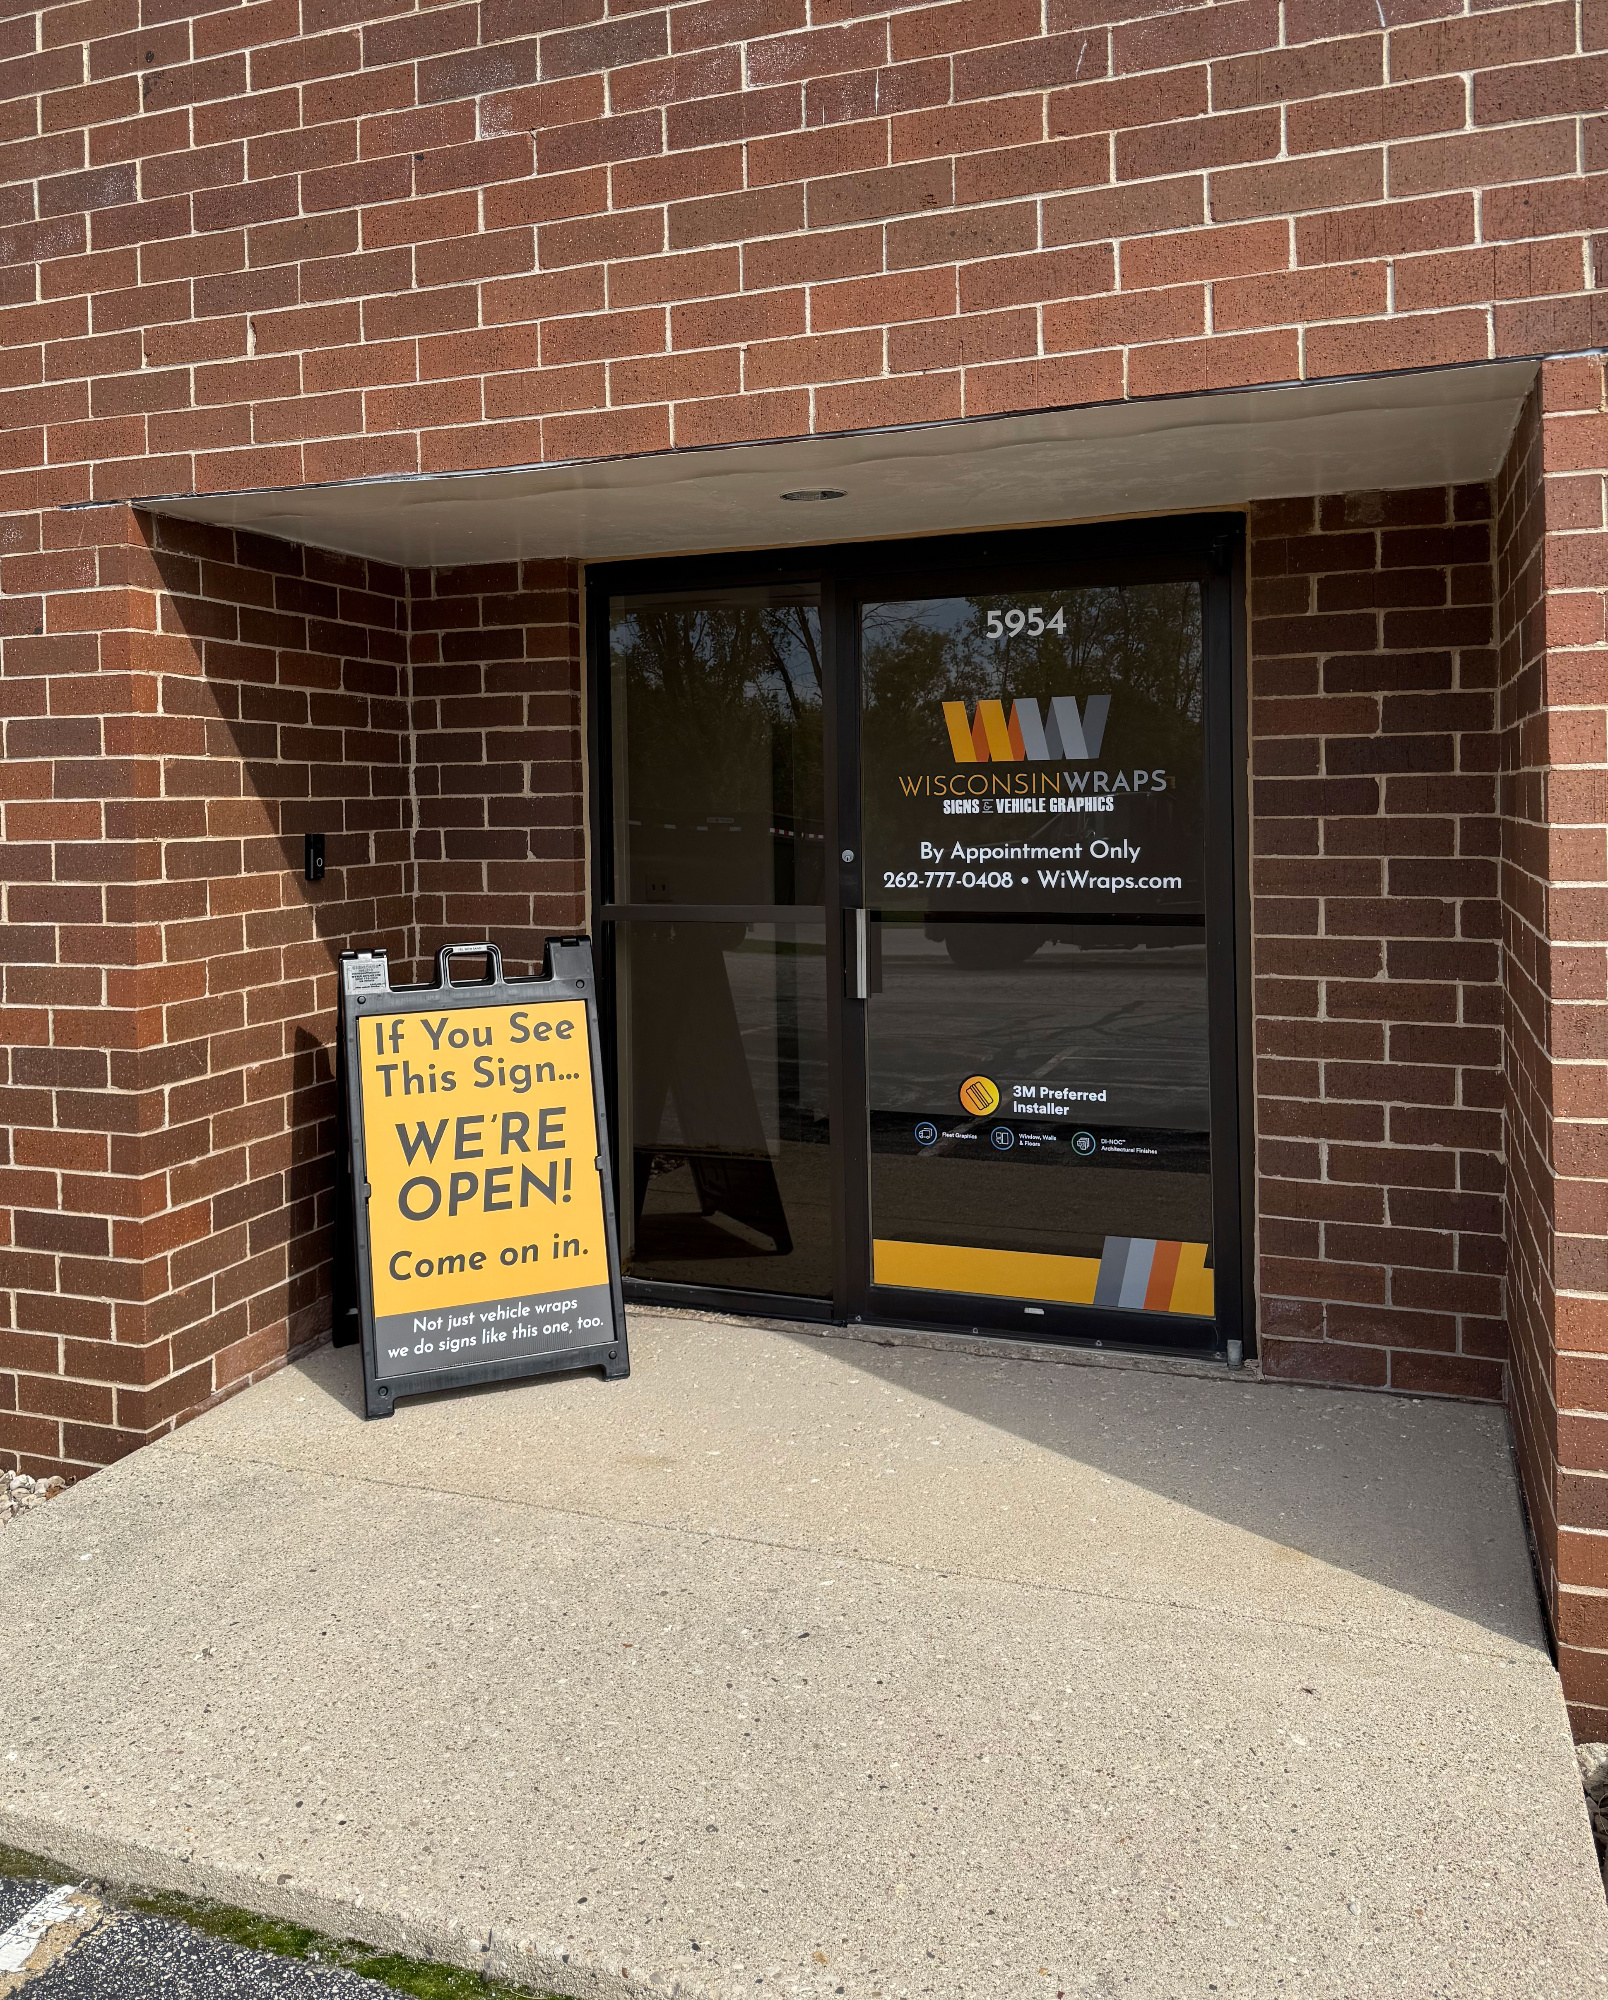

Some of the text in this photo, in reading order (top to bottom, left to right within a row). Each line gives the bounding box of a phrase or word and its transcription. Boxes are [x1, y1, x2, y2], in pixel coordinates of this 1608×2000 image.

[985, 606, 1067, 639] 5954
[942, 796, 1114, 815] SIGNS & VEHICLE GRAPHICS
[919, 838, 1141, 864] By Appointment Only
[883, 869, 1182, 894] 262-777-0408 WiWraps.com
[375, 1011, 575, 1056] If You See
[375, 1055, 580, 1098] This Sign...
[1012, 1085, 1107, 1102] 3M Preferred
[1013, 1100, 1070, 1116] Installer
[394, 1106, 567, 1168] WE'RE
[955, 1131, 978, 1140] Graphics
[1100, 1145, 1158, 1155] Architectural Finishes
[398, 1157, 572, 1222] OPEN!
[389, 1233, 589, 1281] Come on in.
[413, 1299, 578, 1333] Not just vehicle wraps
[388, 1316, 604, 1359] we do signs like this one, too.
